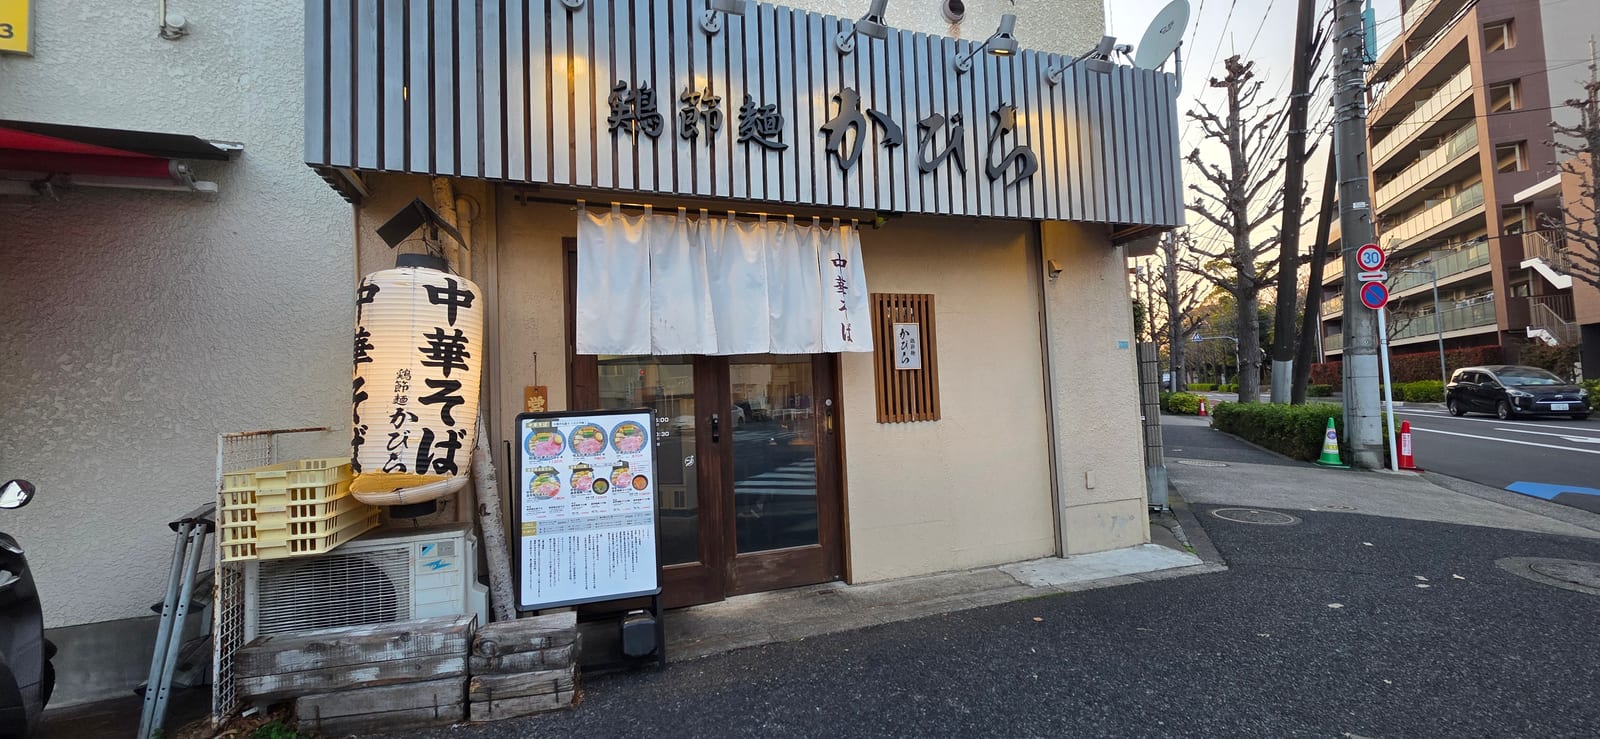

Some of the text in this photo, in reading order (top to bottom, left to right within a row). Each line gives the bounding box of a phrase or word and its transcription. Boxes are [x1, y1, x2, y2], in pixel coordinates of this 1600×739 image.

[607, 79, 1038, 188] 鶏節麺 かびら
[1363, 251, 1379, 264] 30
[830, 252, 854, 343] 中華そば
[415, 277, 476, 476] 中華そば
[899, 327, 910, 364] かびら
[382, 407, 419, 473] かびら
